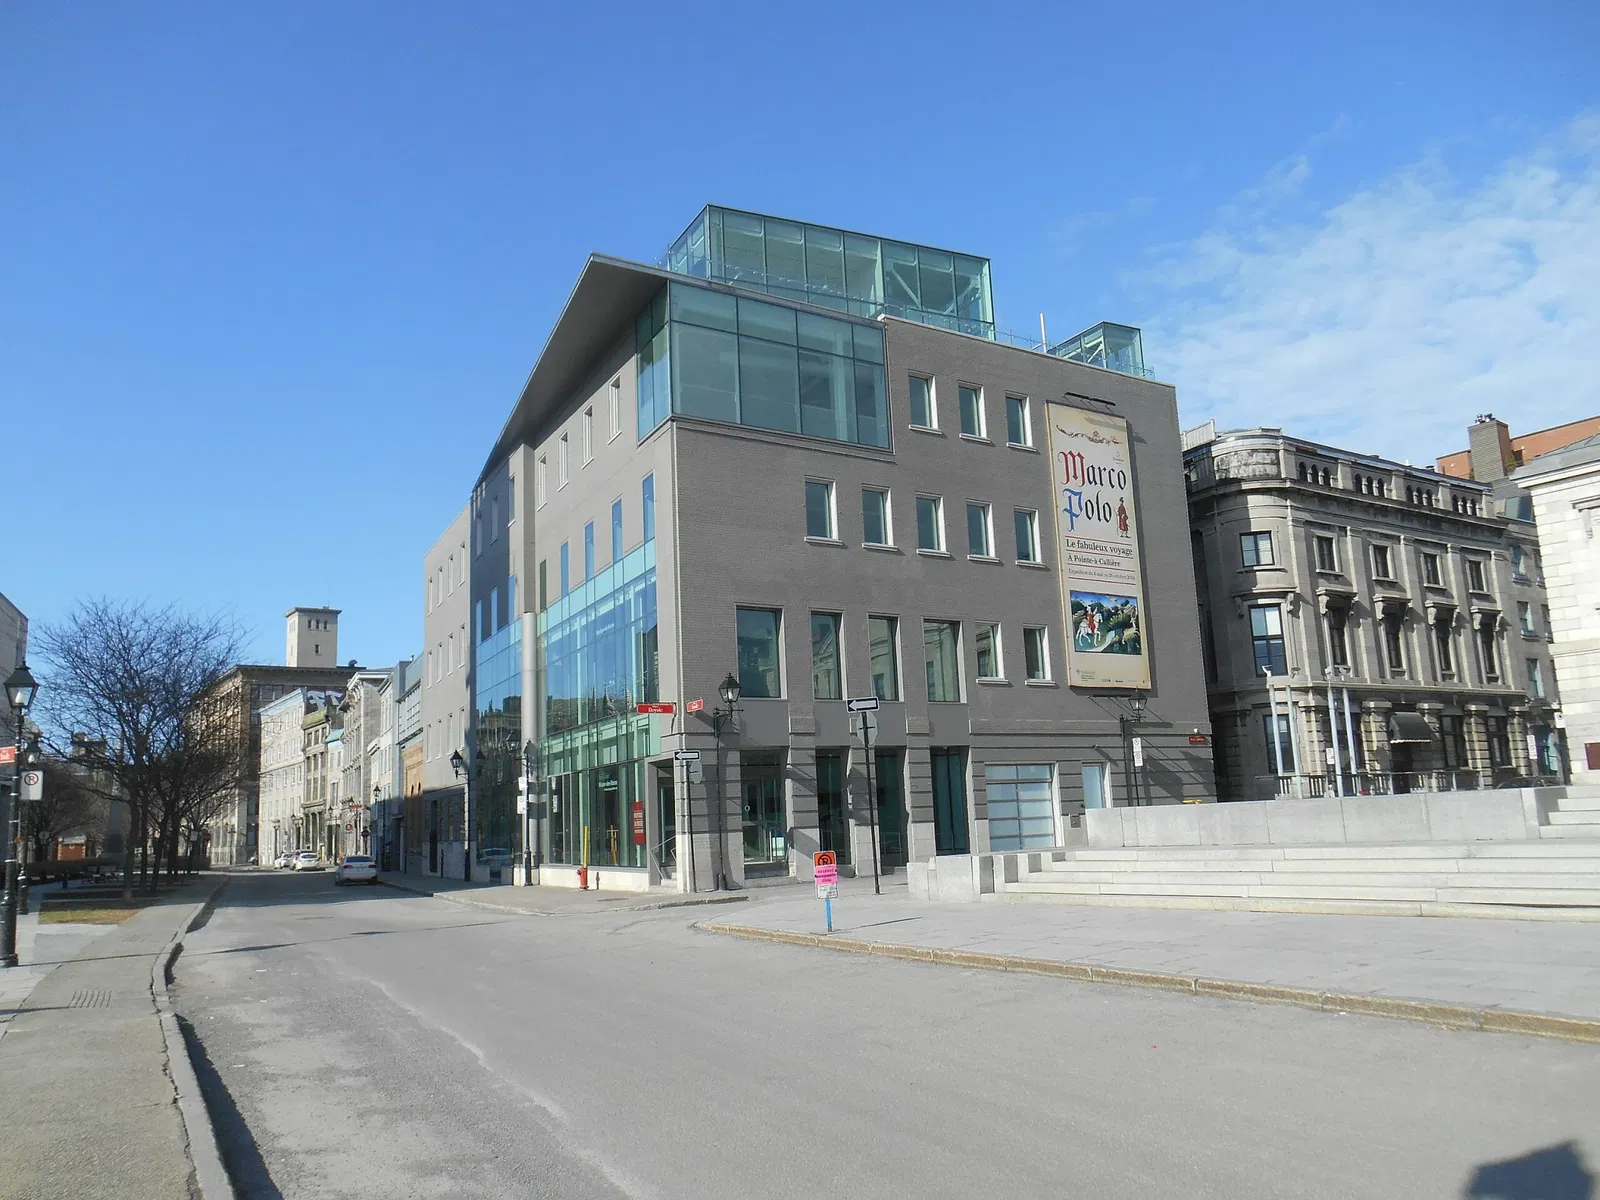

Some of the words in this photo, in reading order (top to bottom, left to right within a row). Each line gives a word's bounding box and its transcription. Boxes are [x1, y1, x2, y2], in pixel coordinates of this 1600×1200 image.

[1058, 451, 1126, 490] Marco
[1063, 488, 1112, 532] Polo
[1066, 539, 1075, 548] Le
[1077, 540, 1108, 552] fabuleux
[1110, 546, 1133, 556] voyage
[1074, 555, 1121, 567] Pointe-à-Callière
